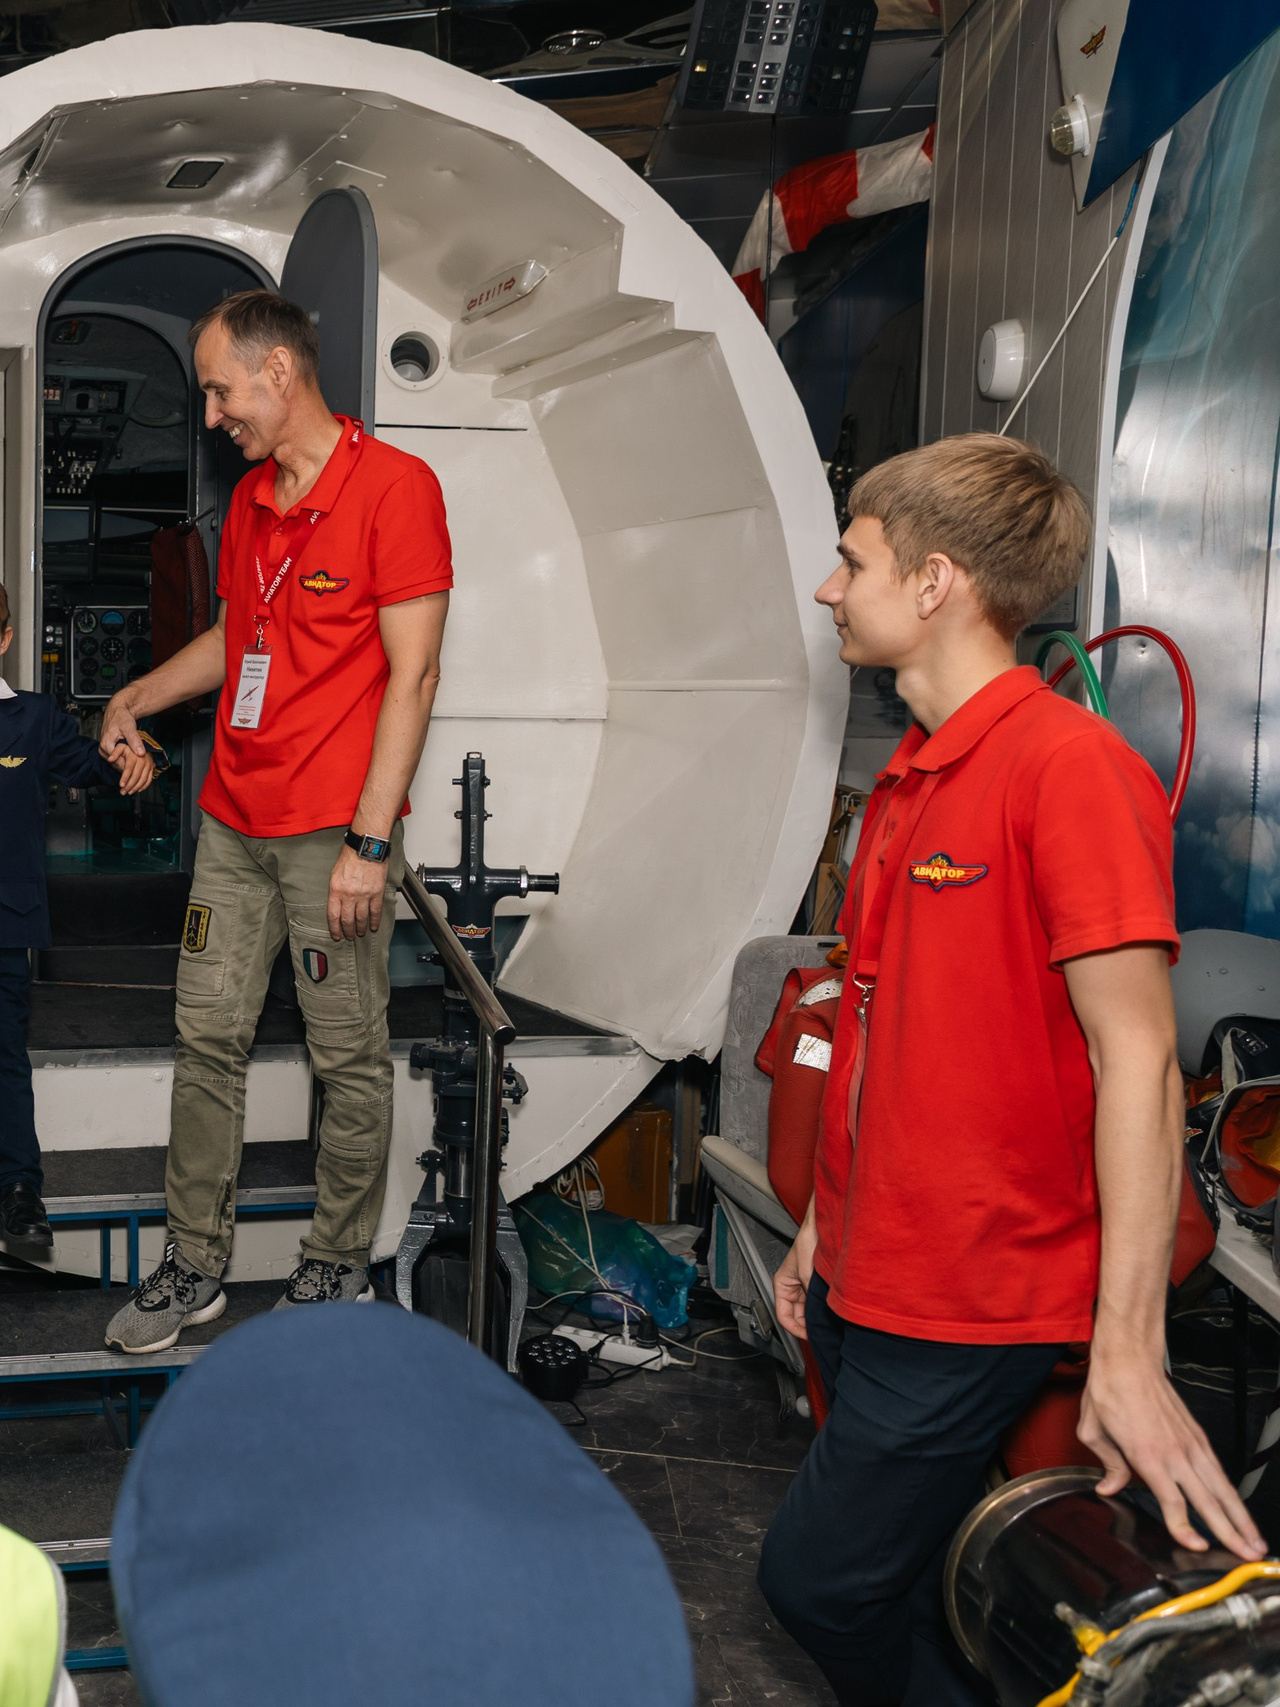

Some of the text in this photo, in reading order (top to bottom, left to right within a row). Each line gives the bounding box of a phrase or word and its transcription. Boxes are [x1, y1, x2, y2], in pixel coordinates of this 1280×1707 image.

[478, 282, 503, 307] EXIT
[263, 556, 293, 604] AVIATOR TEAM
[303, 580, 337, 589] АВИАТОР
[913, 866, 966, 880] АВИАТОР
